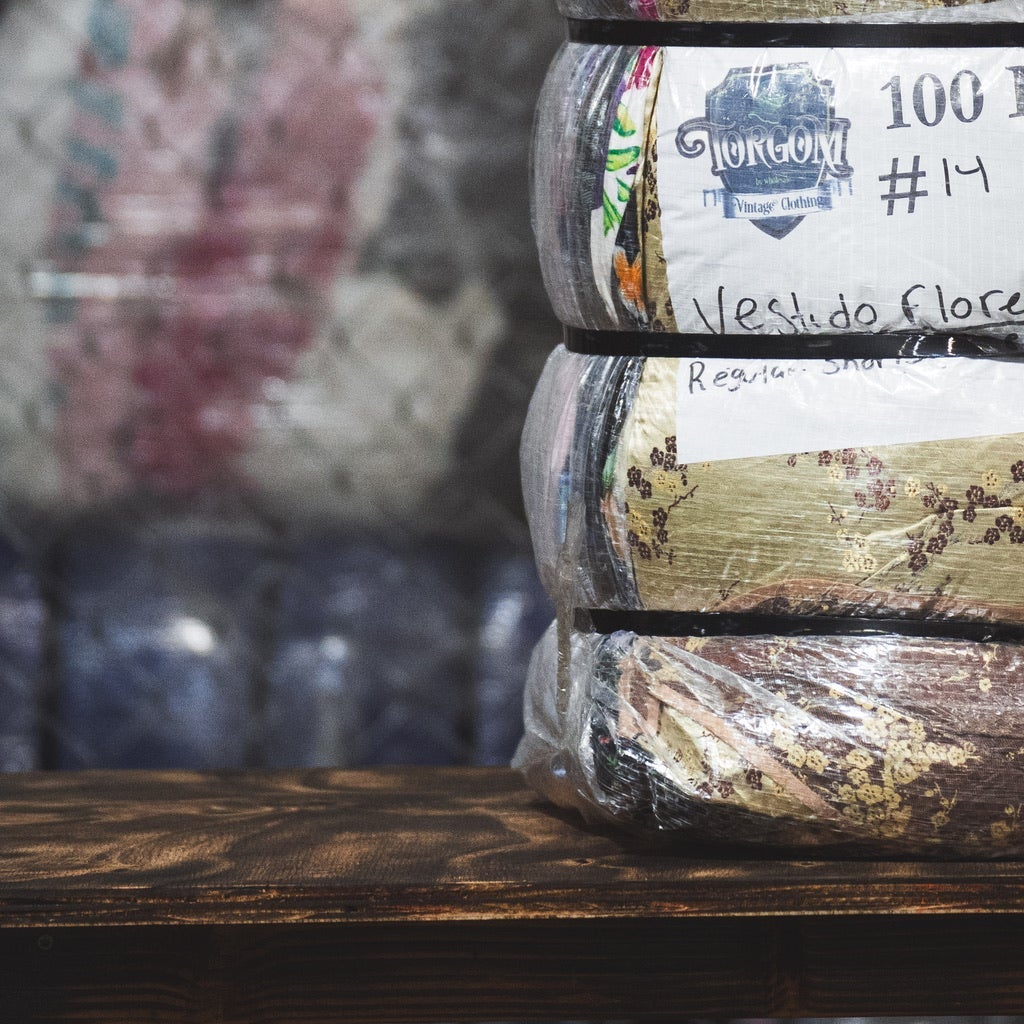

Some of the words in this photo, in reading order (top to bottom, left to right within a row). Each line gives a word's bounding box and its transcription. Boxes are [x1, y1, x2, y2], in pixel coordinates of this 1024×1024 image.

[880, 69, 985, 130] 100
[675, 114, 854, 178] TORGOM
[735, 198, 775, 215] Vintage
[780, 194, 825, 211] Clothing
[878, 154, 990, 216] #14
